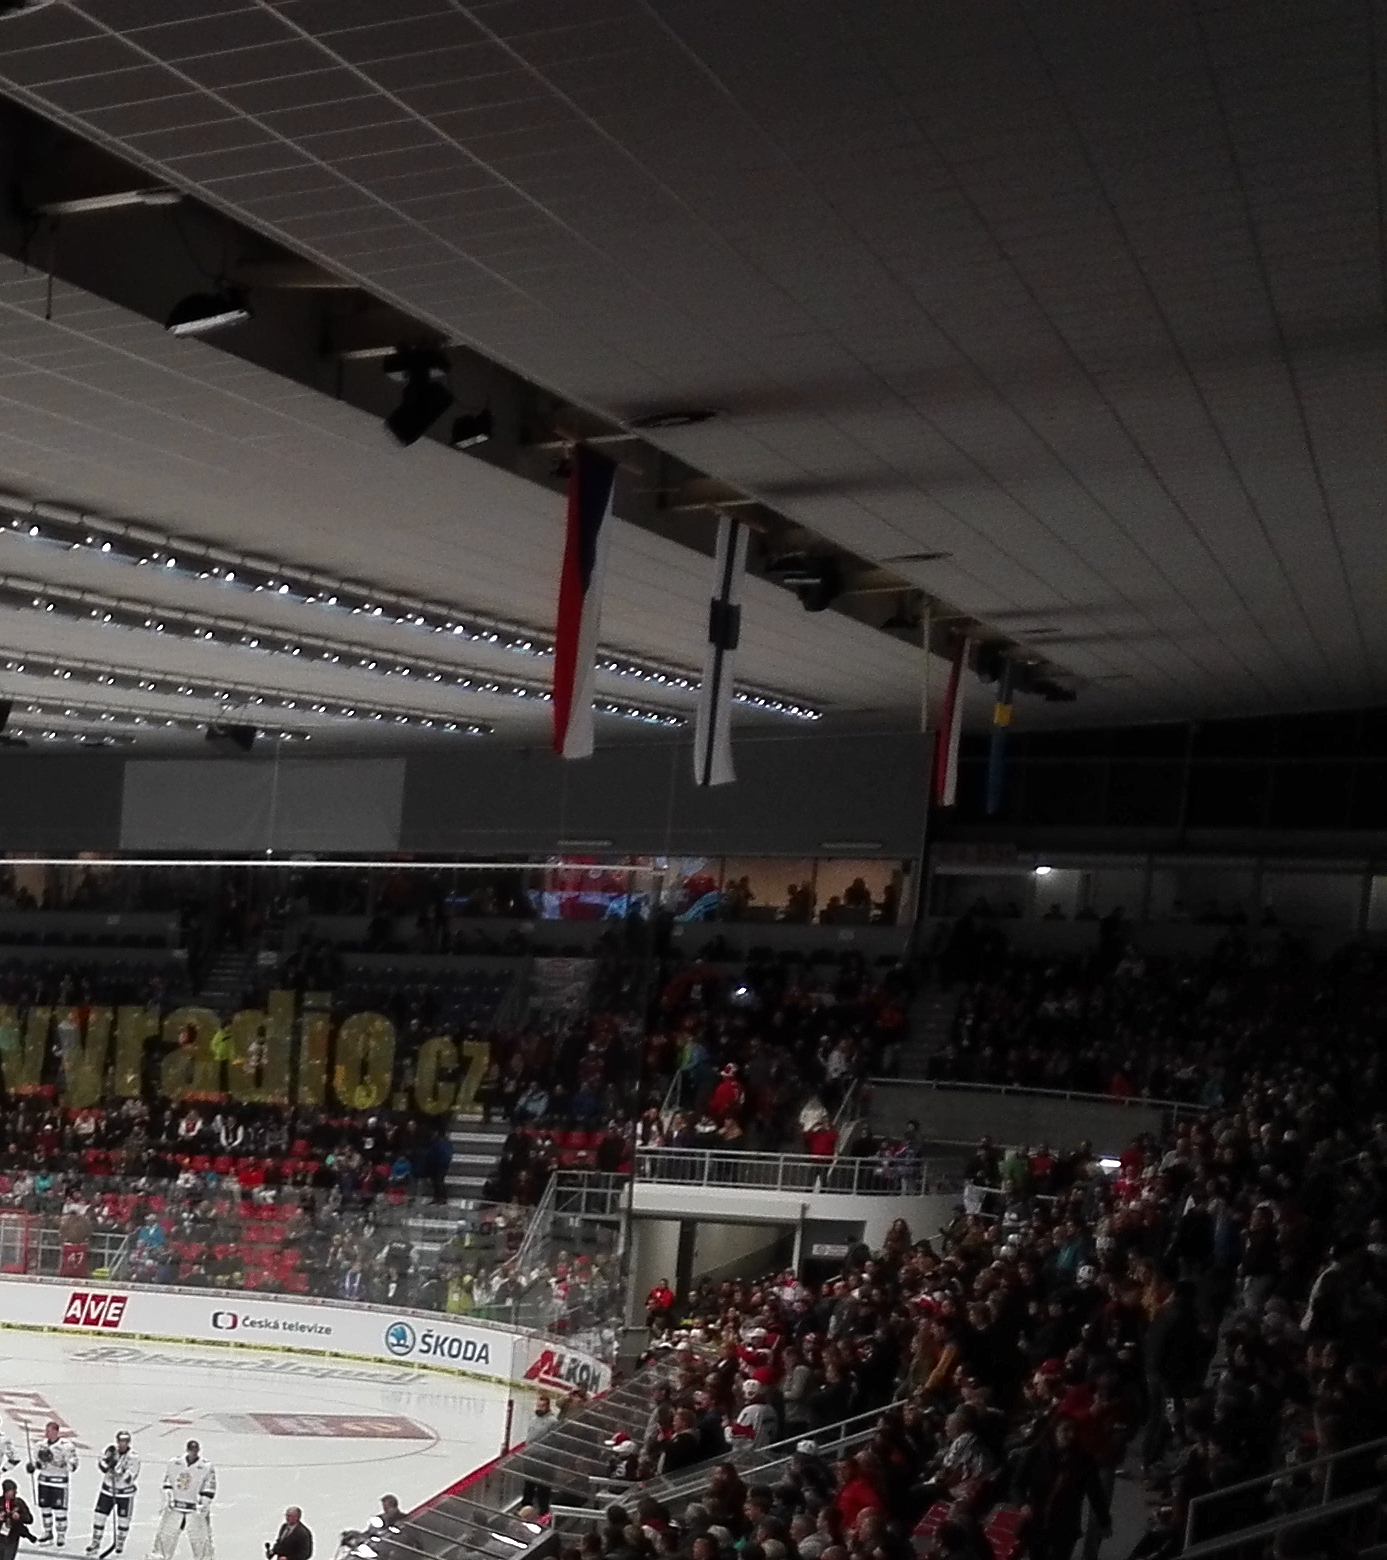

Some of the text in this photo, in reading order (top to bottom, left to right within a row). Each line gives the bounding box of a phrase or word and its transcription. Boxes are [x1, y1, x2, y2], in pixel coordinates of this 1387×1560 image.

[66, 1295, 126, 1326] AVE
[241, 1314, 332, 1335] Česká televize
[418, 1327, 491, 1365] ŠKODA
